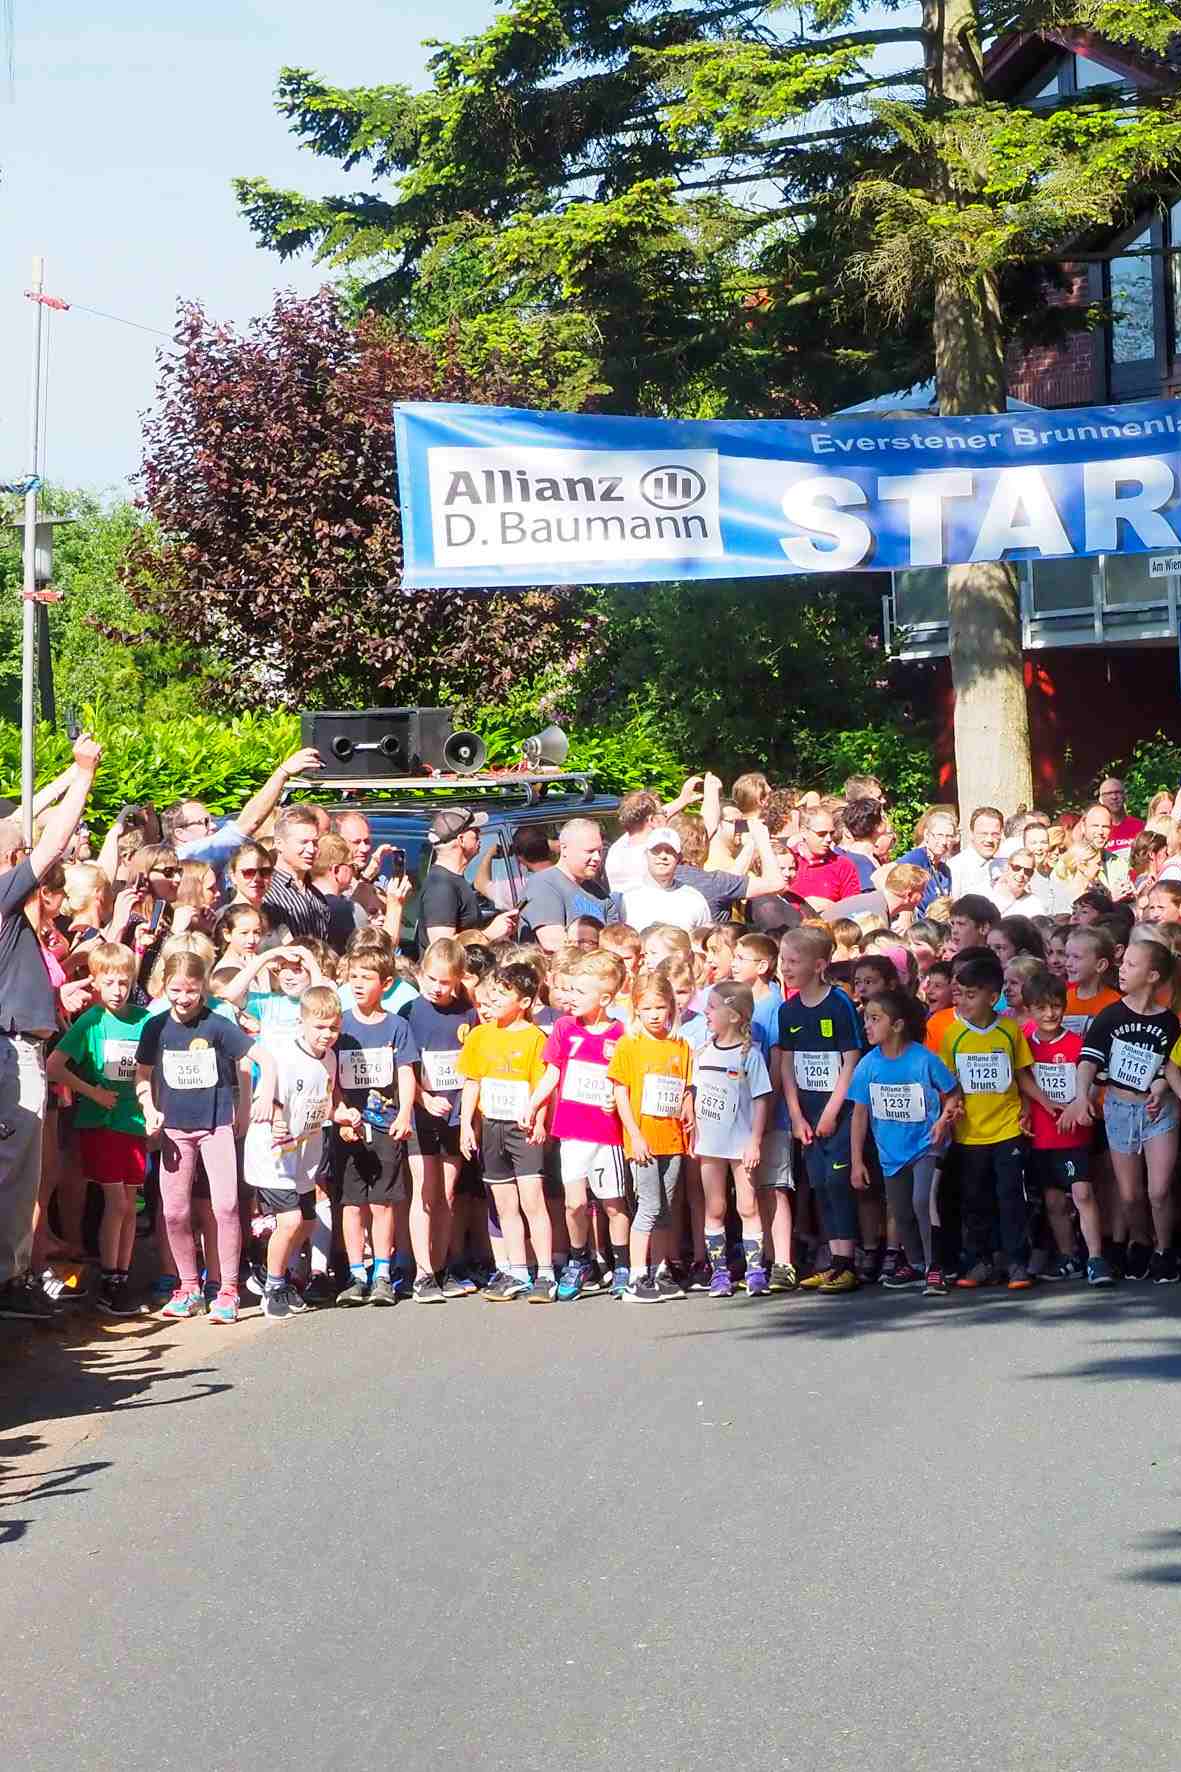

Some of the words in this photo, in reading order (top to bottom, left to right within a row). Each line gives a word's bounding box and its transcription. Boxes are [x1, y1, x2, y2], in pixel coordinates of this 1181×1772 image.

[810, 428, 1001, 456] Everstener
[444, 470, 625, 506] Allianz
[445, 514, 489, 549] D.
[499, 513, 709, 546] Baumann
[1152, 560, 1164, 573] Am
[569, 1036, 584, 1057] 7
[177, 1064, 200, 1075] 356
[353, 1063, 383, 1074] 1576
[804, 1066, 830, 1077] 1204
[1121, 1058, 1148, 1075] 1116
[969, 1068, 998, 1079] 1128
[1118, 1067, 1142, 1086] bruns
[807, 1077, 828, 1088] bruns
[971, 1080, 997, 1090] bruns
[1041, 1077, 1067, 1088] 1125
[657, 1091, 680, 1104] 1136
[701, 1094, 725, 1111] 2673
[882, 1098, 911, 1109] 1237
[886, 1108, 911, 1119] bruns
[594, 1167, 605, 1188] 7
